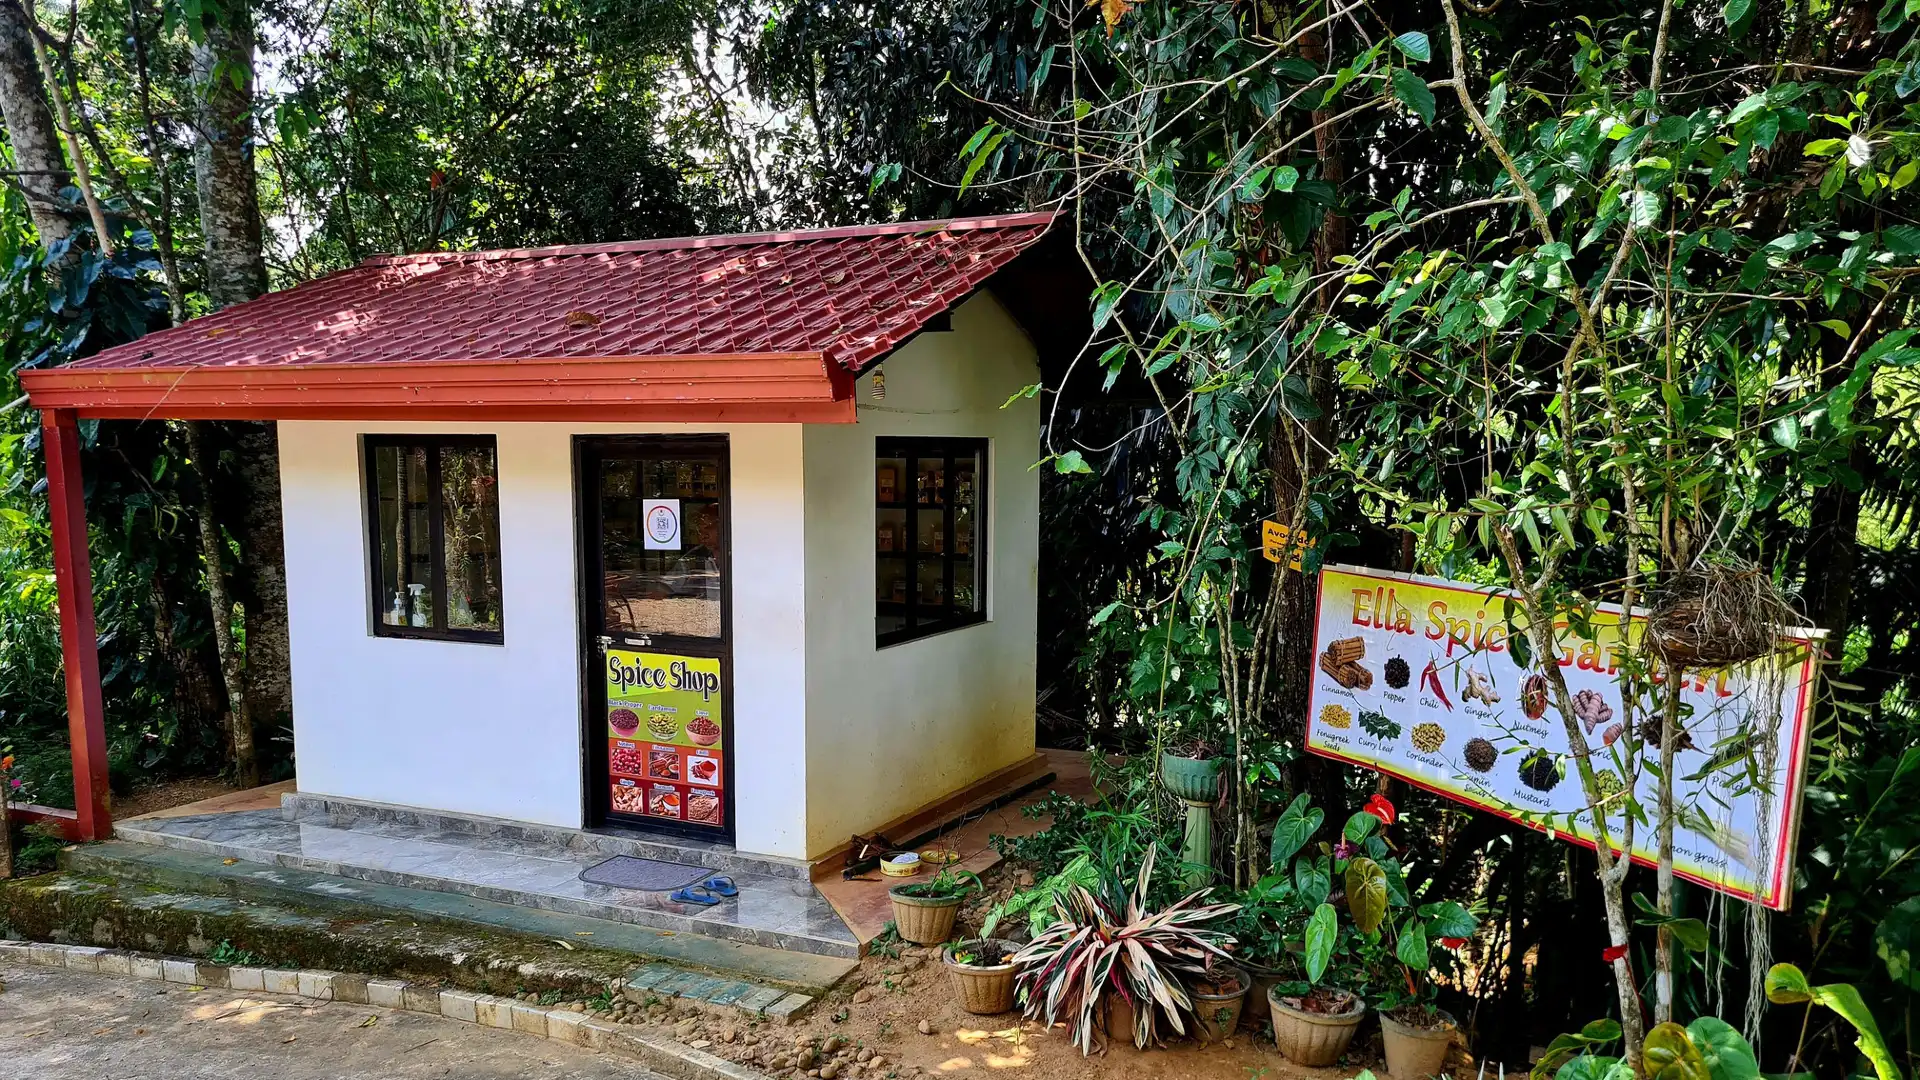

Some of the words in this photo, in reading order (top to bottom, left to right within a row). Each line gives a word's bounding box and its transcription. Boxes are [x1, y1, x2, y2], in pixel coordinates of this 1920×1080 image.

[1352, 586, 1414, 635] Ella
[1424, 600, 1513, 657] Spic
[608, 656, 668, 694] Spice
[669, 661, 720, 701] Shop
[1321, 684, 1355, 698] Cinnamon
[1383, 690, 1406, 704] Pepper
[1419, 697, 1440, 710] Chili
[1464, 705, 1492, 719] Ginger
[1316, 729, 1350, 745] Fenugreek
[1512, 719, 1549, 739] Nutmeg
[1323, 740, 1341, 752] Seeds
[1358, 737, 1377, 750] Curry
[1379, 742, 1394, 754] Leaf
[1406, 750, 1444, 769] Coriander
[1513, 788, 1551, 808] Mustard
